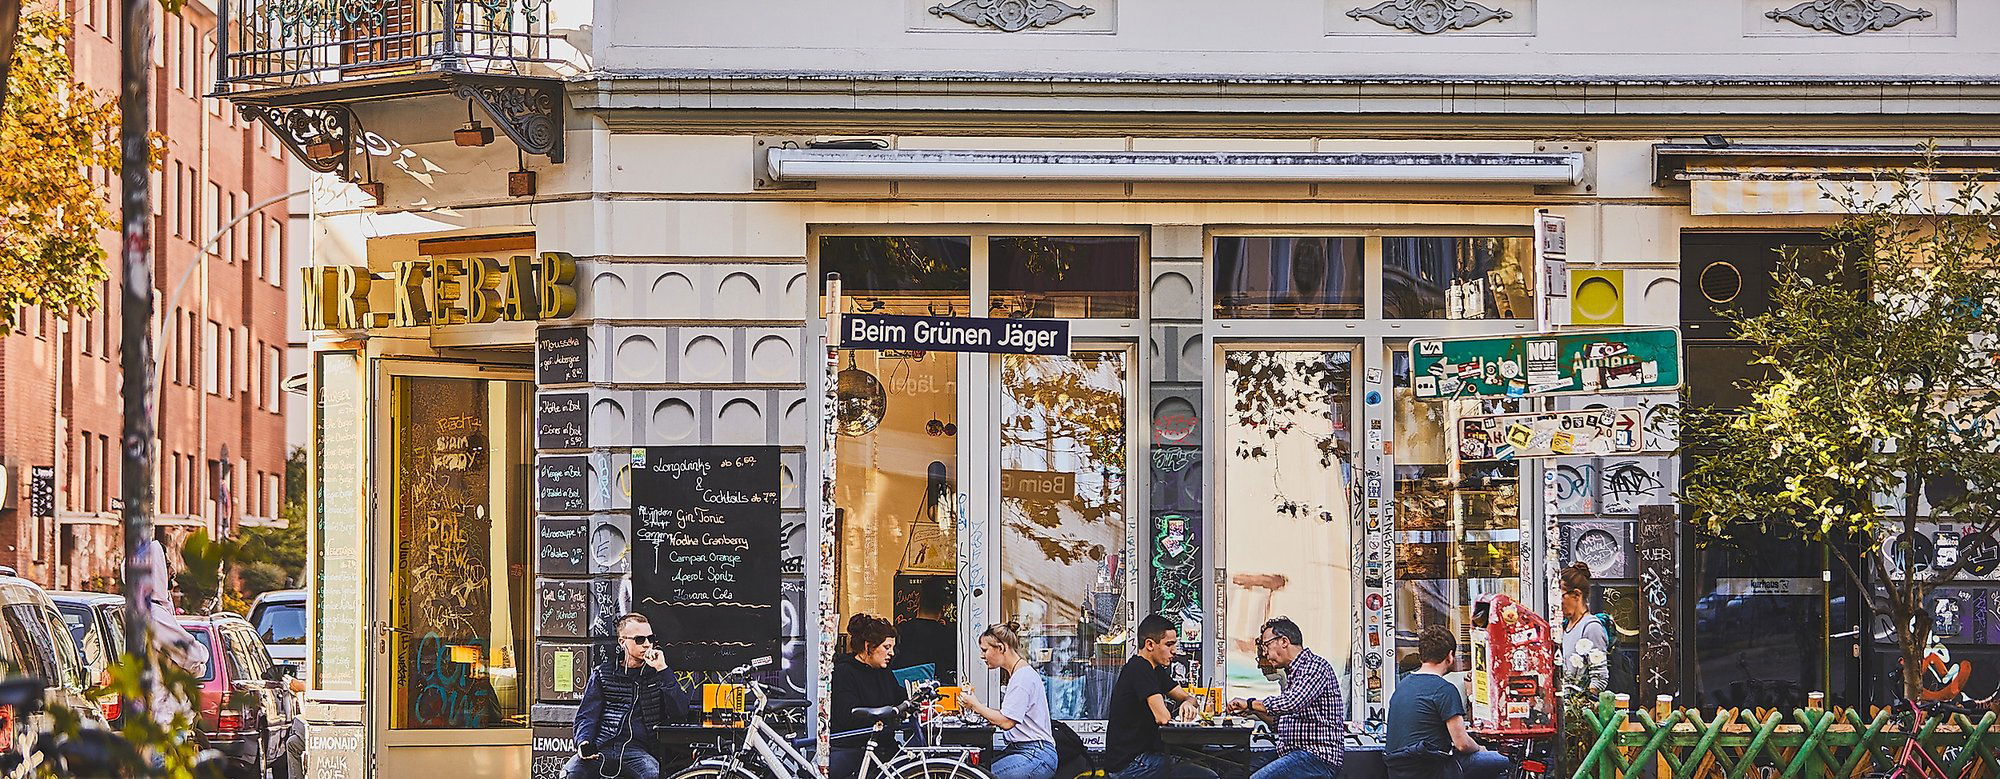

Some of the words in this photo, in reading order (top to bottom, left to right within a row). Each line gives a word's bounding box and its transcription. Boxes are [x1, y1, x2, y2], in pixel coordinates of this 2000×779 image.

[300, 264, 389, 331] MR.
[392, 252, 577, 328] KEBAB
[851, 318, 906, 343] Beim
[913, 320, 991, 346] Grünen
[997, 323, 1059, 352] Jäger
[1528, 342, 1556, 361] NO!
[653, 457, 711, 480] Longdrinks
[720, 459, 732, 468] ab
[702, 489, 749, 503] Cocktails
[676, 509, 695, 529] Gin
[694, 506, 726, 524] Tonic
[669, 531, 698, 546] Wodka
[702, 532, 749, 551] Cranberry
[709, 552, 742, 569] Orange
[671, 567, 704, 585] Aperol
[707, 566, 737, 584] Spritz
[712, 587, 733, 600] Cola
[310, 736, 358, 751] LEMONAID
[533, 737, 577, 752] LEMONA
